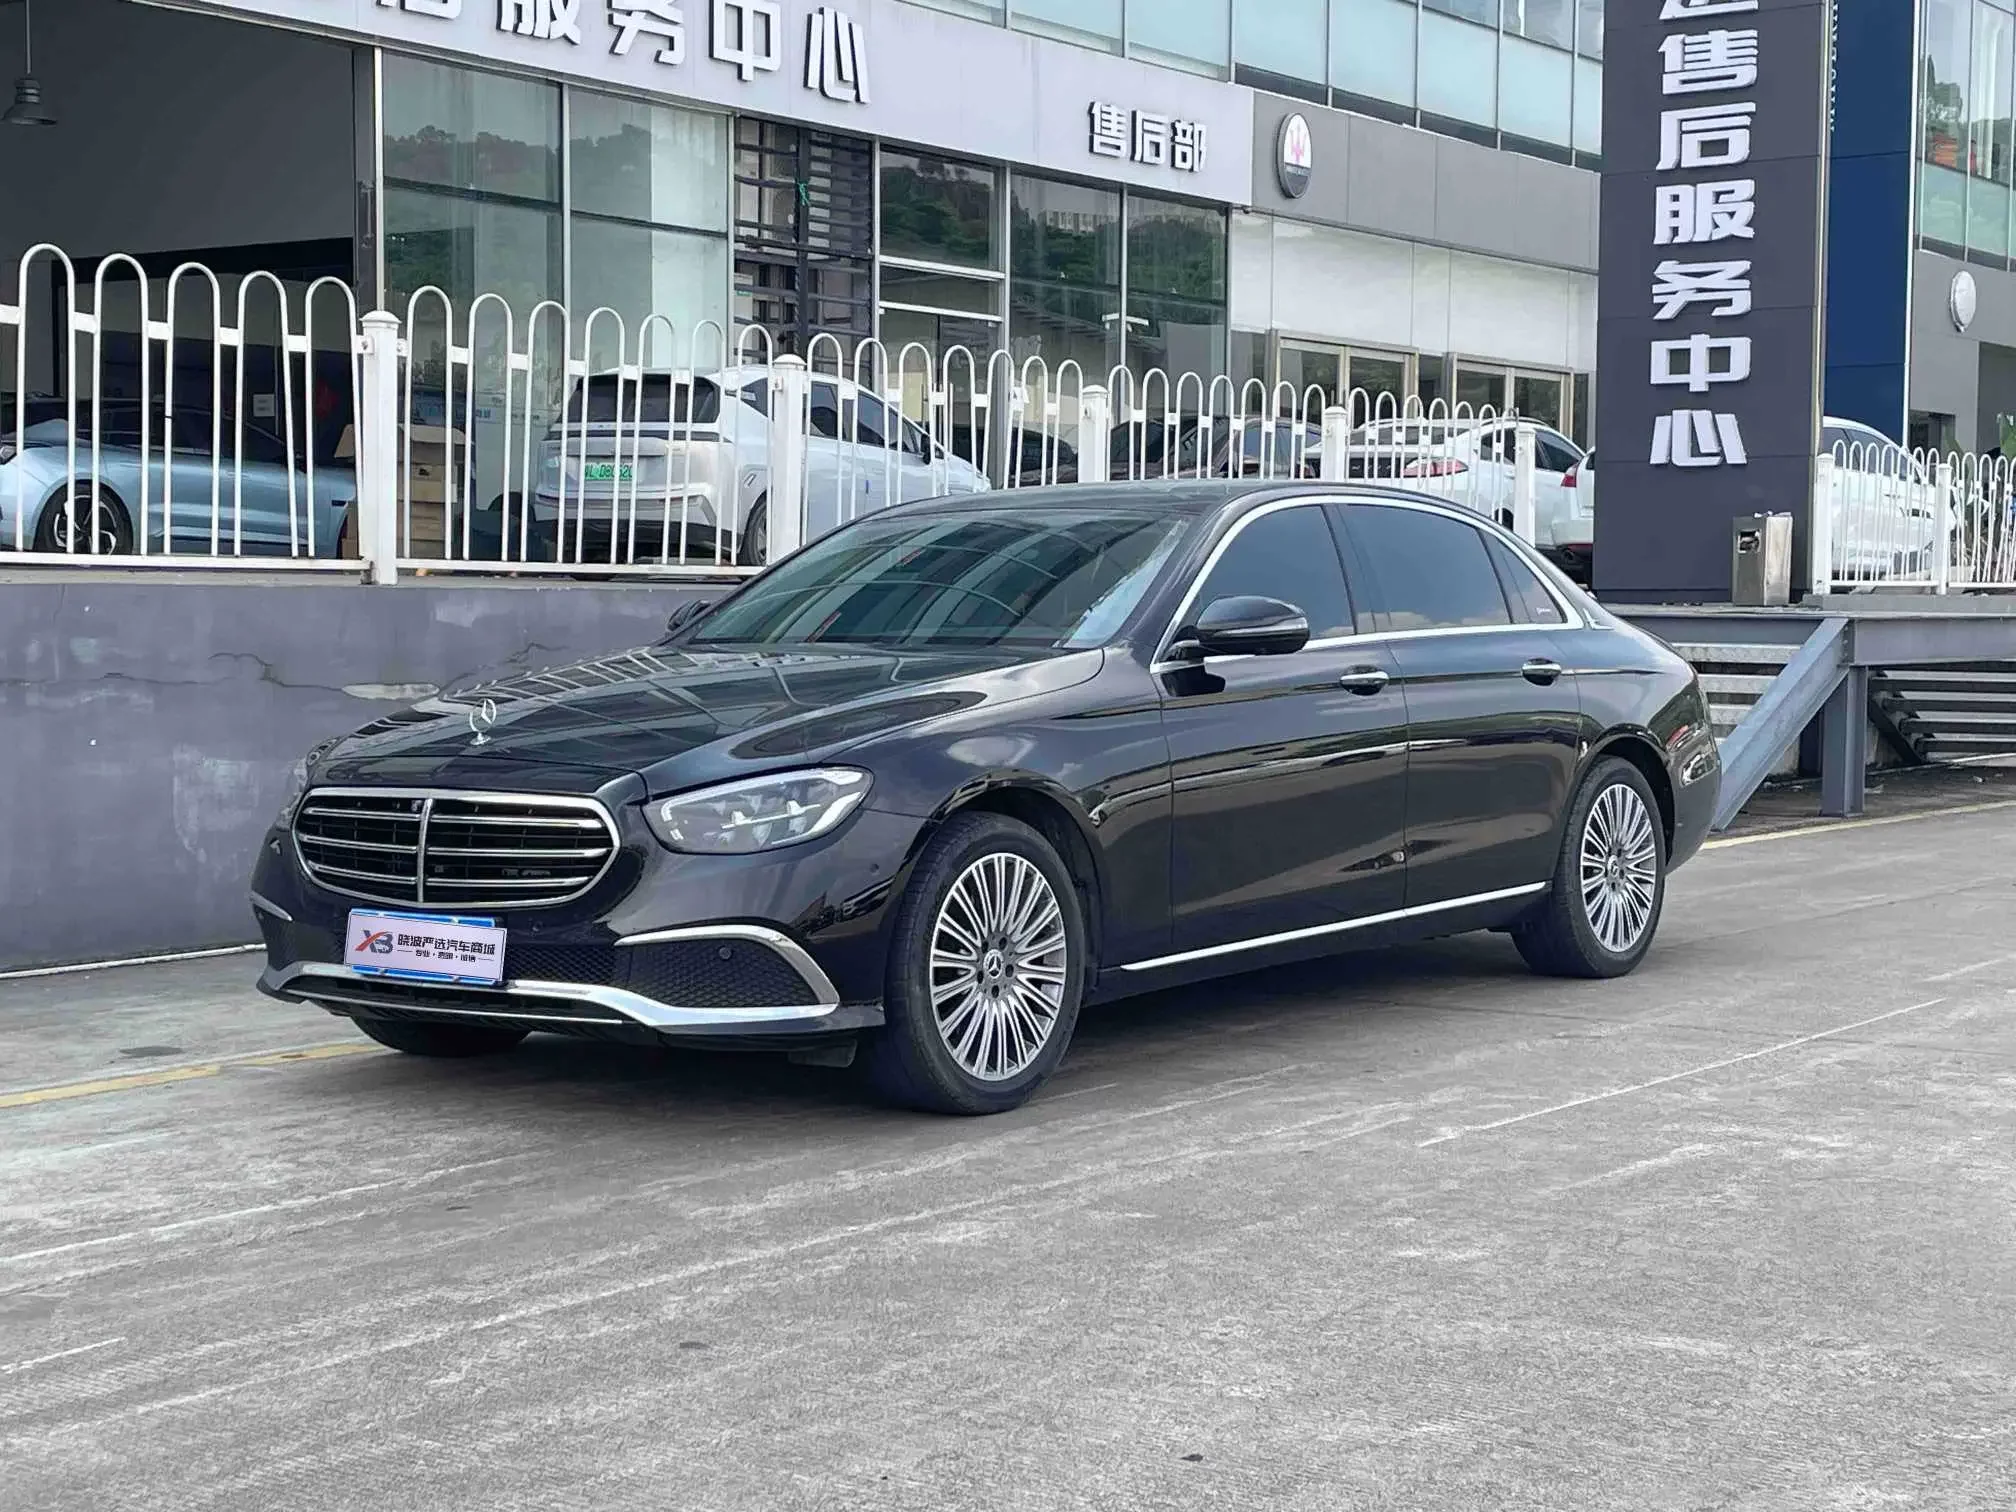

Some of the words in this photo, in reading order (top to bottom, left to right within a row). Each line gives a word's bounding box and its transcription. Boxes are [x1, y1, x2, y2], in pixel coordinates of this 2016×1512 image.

[1089, 101, 1208, 173] 售后部
[1649, 0, 1759, 467] 售后服务中心
[397, 933, 496, 956] 晓波严选汽车商城
